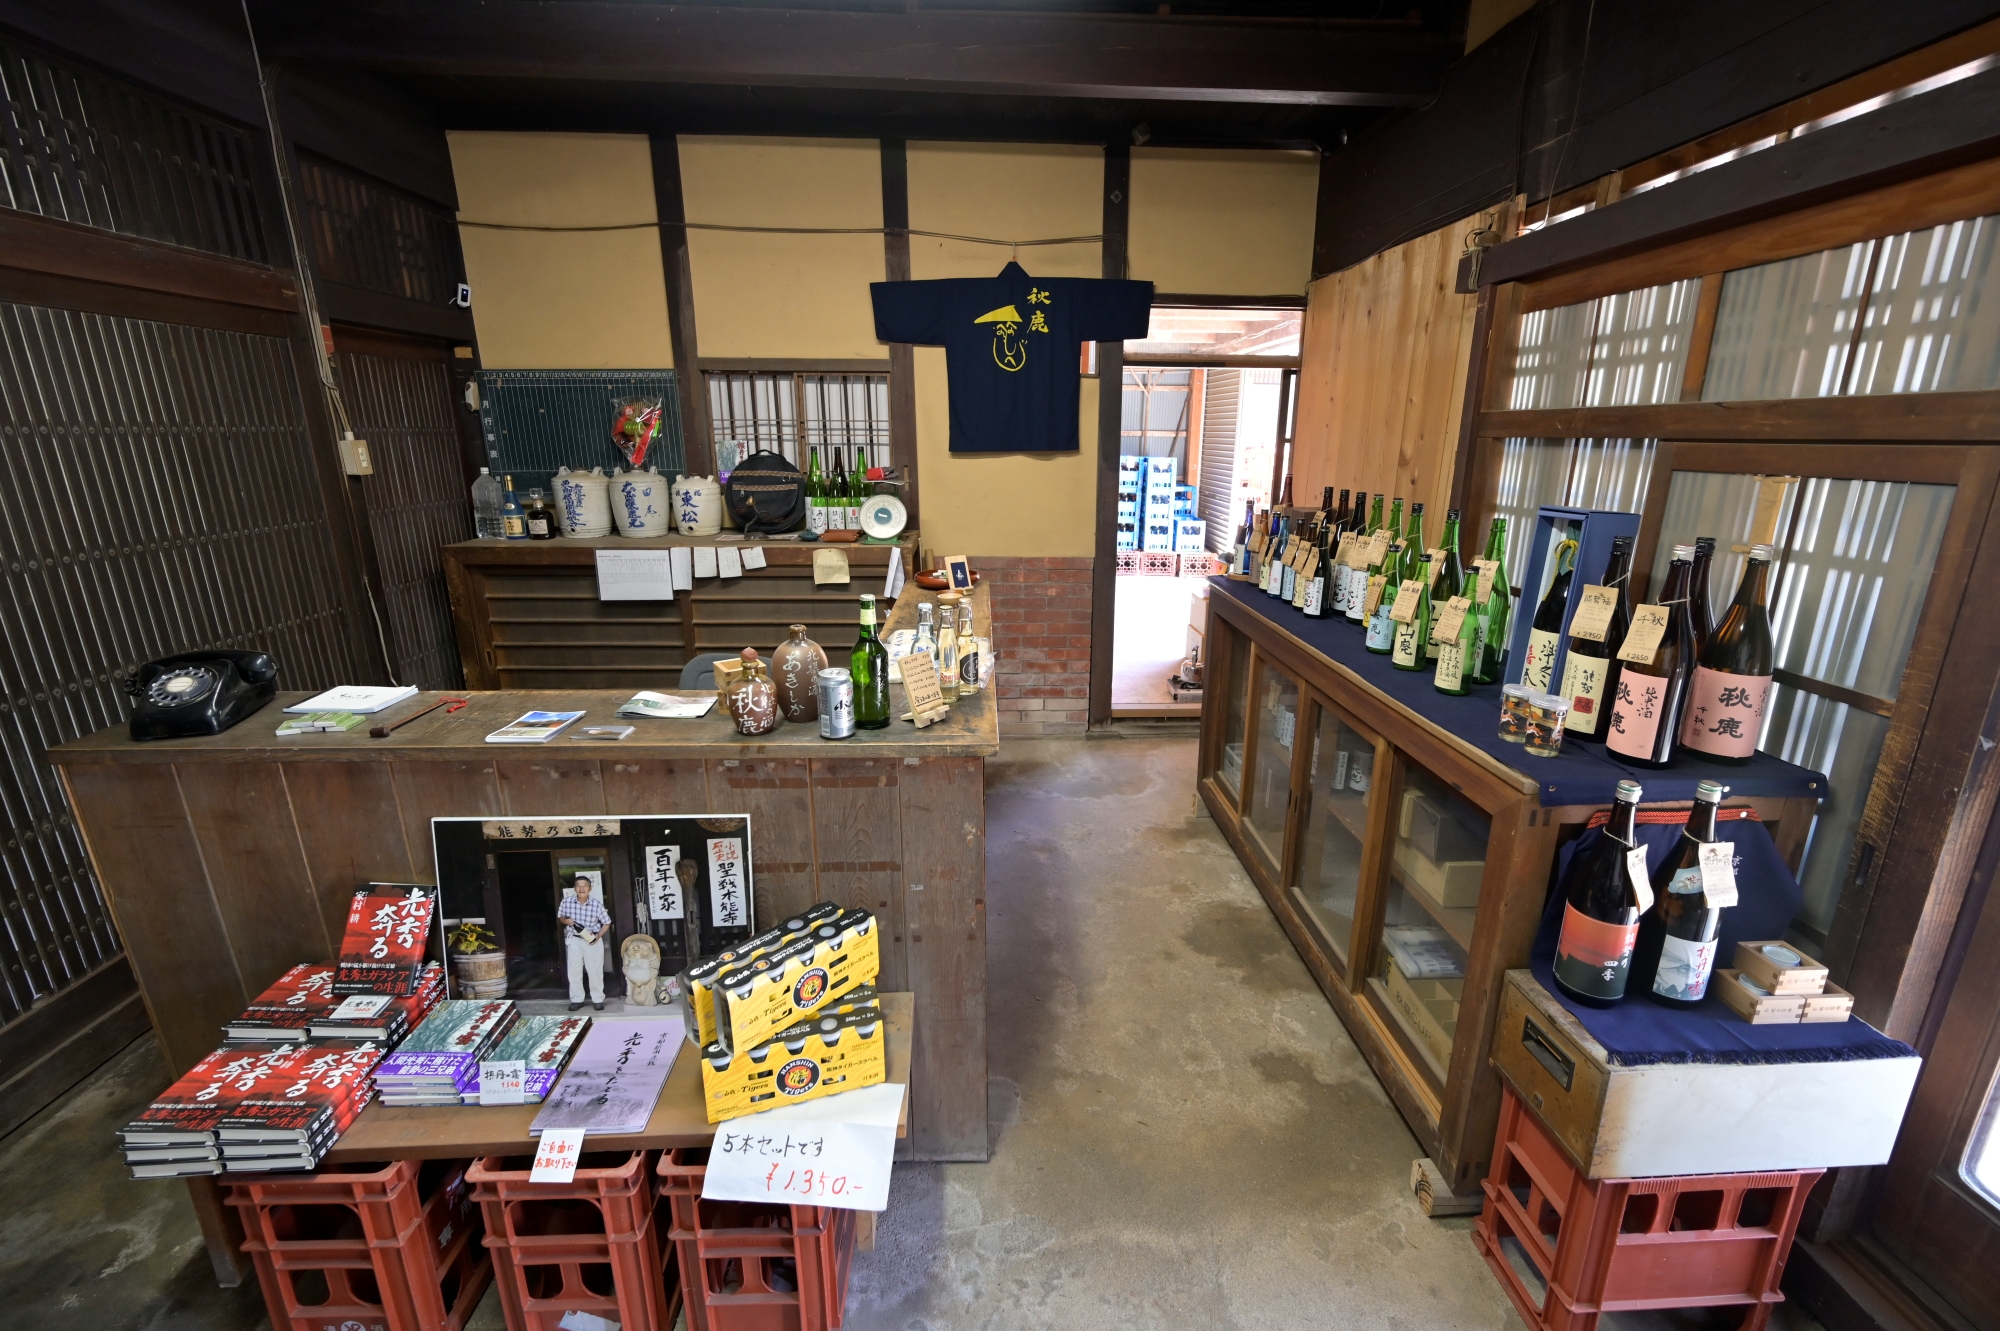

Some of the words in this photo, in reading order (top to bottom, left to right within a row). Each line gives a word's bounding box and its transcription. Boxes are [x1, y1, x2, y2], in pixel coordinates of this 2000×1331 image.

[1026, 287, 1052, 334] 秋鹿
[482, 400, 498, 458] 月行事表
[680, 489, 700, 523] 東松
[1583, 593, 1612, 606] 能勢福
[1636, 614, 1665, 627] 千秋
[1626, 653, 1649, 661] ¥2650
[782, 650, 805, 717] あきしか
[731, 684, 764, 734] 秋鹿
[1610, 681, 1633, 735] 秋鹿
[1636, 686, 1658, 719] 純米酒
[1708, 686, 1753, 739] 秋鹿
[1693, 705, 1709, 726] 千秋
[497, 823, 609, 838] 能勢乃四季
[712, 840, 726, 862] 歴史
[725, 841, 739, 861] 小説
[653, 848, 676, 912] 百年の家
[395, 887, 427, 949] 光秀
[369, 903, 401, 959] 奔る
[833, 950, 874, 977] 阪神タイガースラベル
[1601, 959, 1619, 982] 四季
[1688, 943, 1711, 997] 摂丹の霧
[337, 969, 410, 981] 光秀とガラシア
[796, 969, 824, 989] HANSHIN
[373, 981, 408, 993] の生涯
[799, 990, 824, 1008] Tigers
[321, 1041, 377, 1089] 光秀
[384, 1055, 463, 1066] 人間光秀に賭けた
[397, 1065, 458, 1075] 能勢の三兄弟
[596, 1032, 645, 1105] 光秀をたどる
[781, 1059, 814, 1076] HANSHIN
[826, 1056, 878, 1073] 阪神タイガースラベル
[284, 1053, 341, 1097] 奔る
[484, 1069, 522, 1080] 摂丹の霧
[741, 1082, 769, 1093] Tigers
[784, 1082, 814, 1096] Tigers
[541, 1140, 574, 1154] ご自由に
[722, 1133, 824, 1158] 5本セットです
[534, 1157, 577, 1170] お取り下さい
